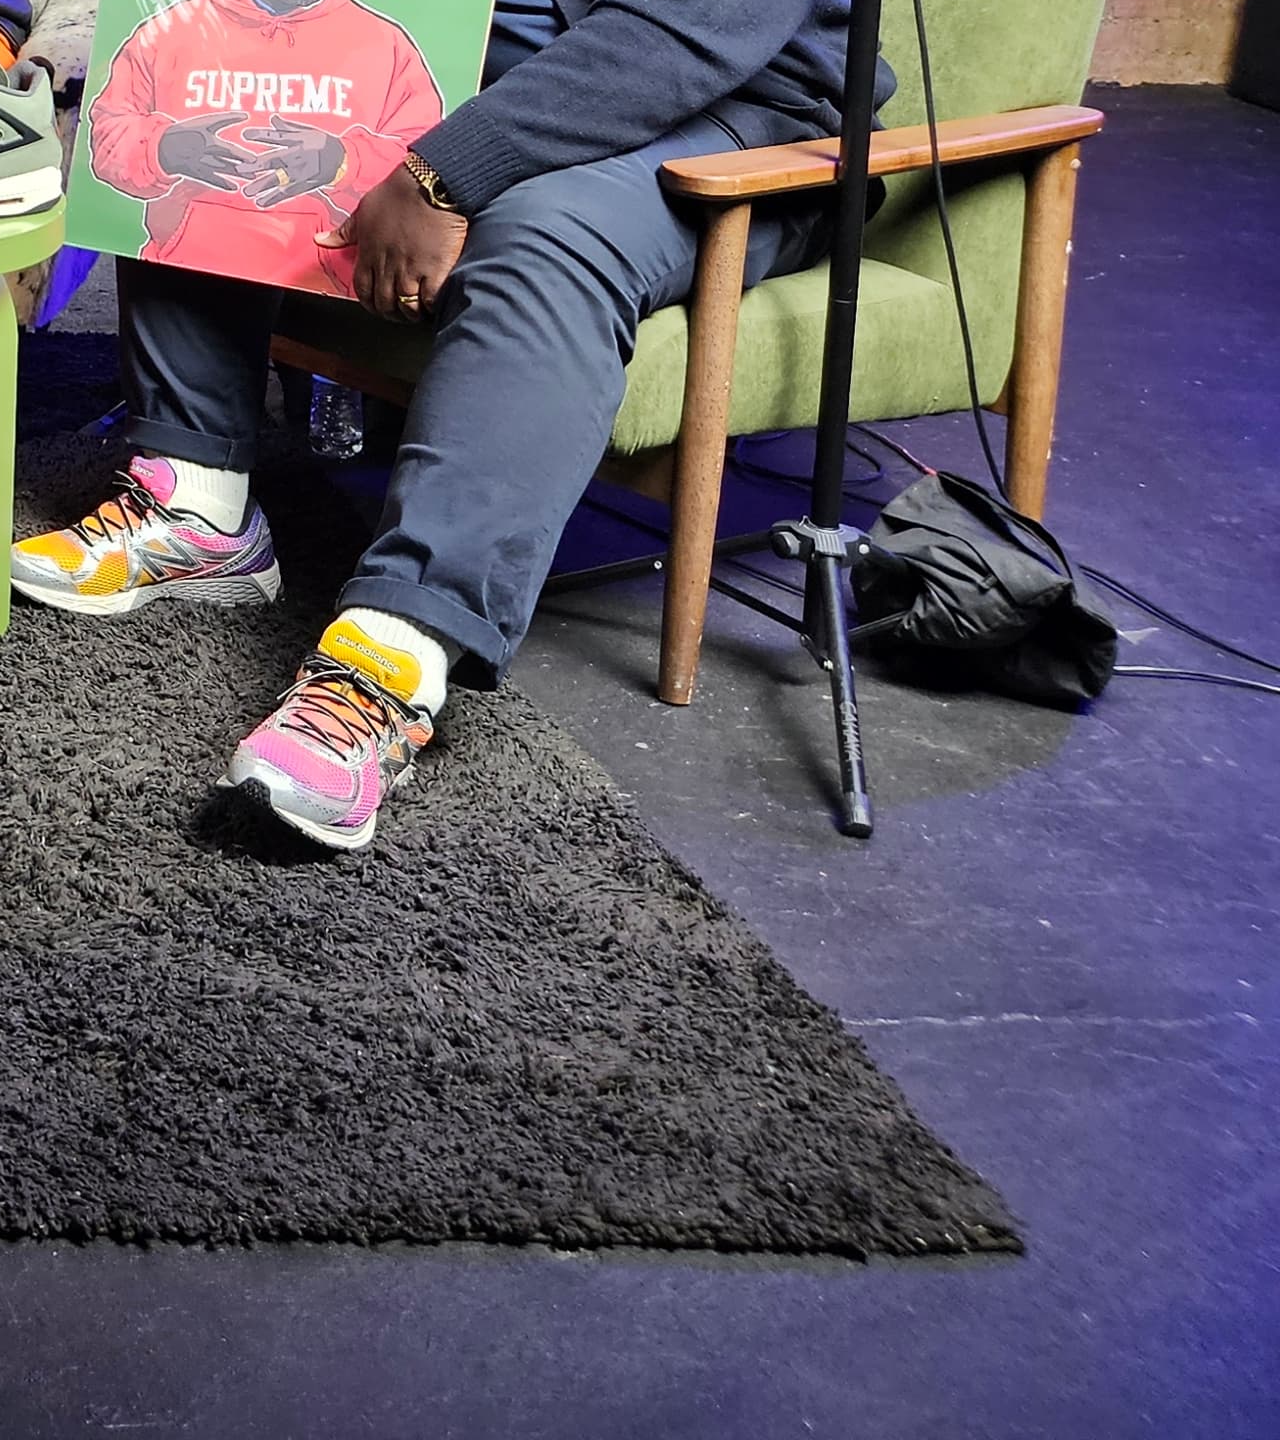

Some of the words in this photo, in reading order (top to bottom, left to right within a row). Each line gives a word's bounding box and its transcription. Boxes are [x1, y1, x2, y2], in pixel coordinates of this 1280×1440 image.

[184, 70, 353, 118] SUPREME
[335, 634, 356, 648] new
[356, 641, 401, 675] balance
